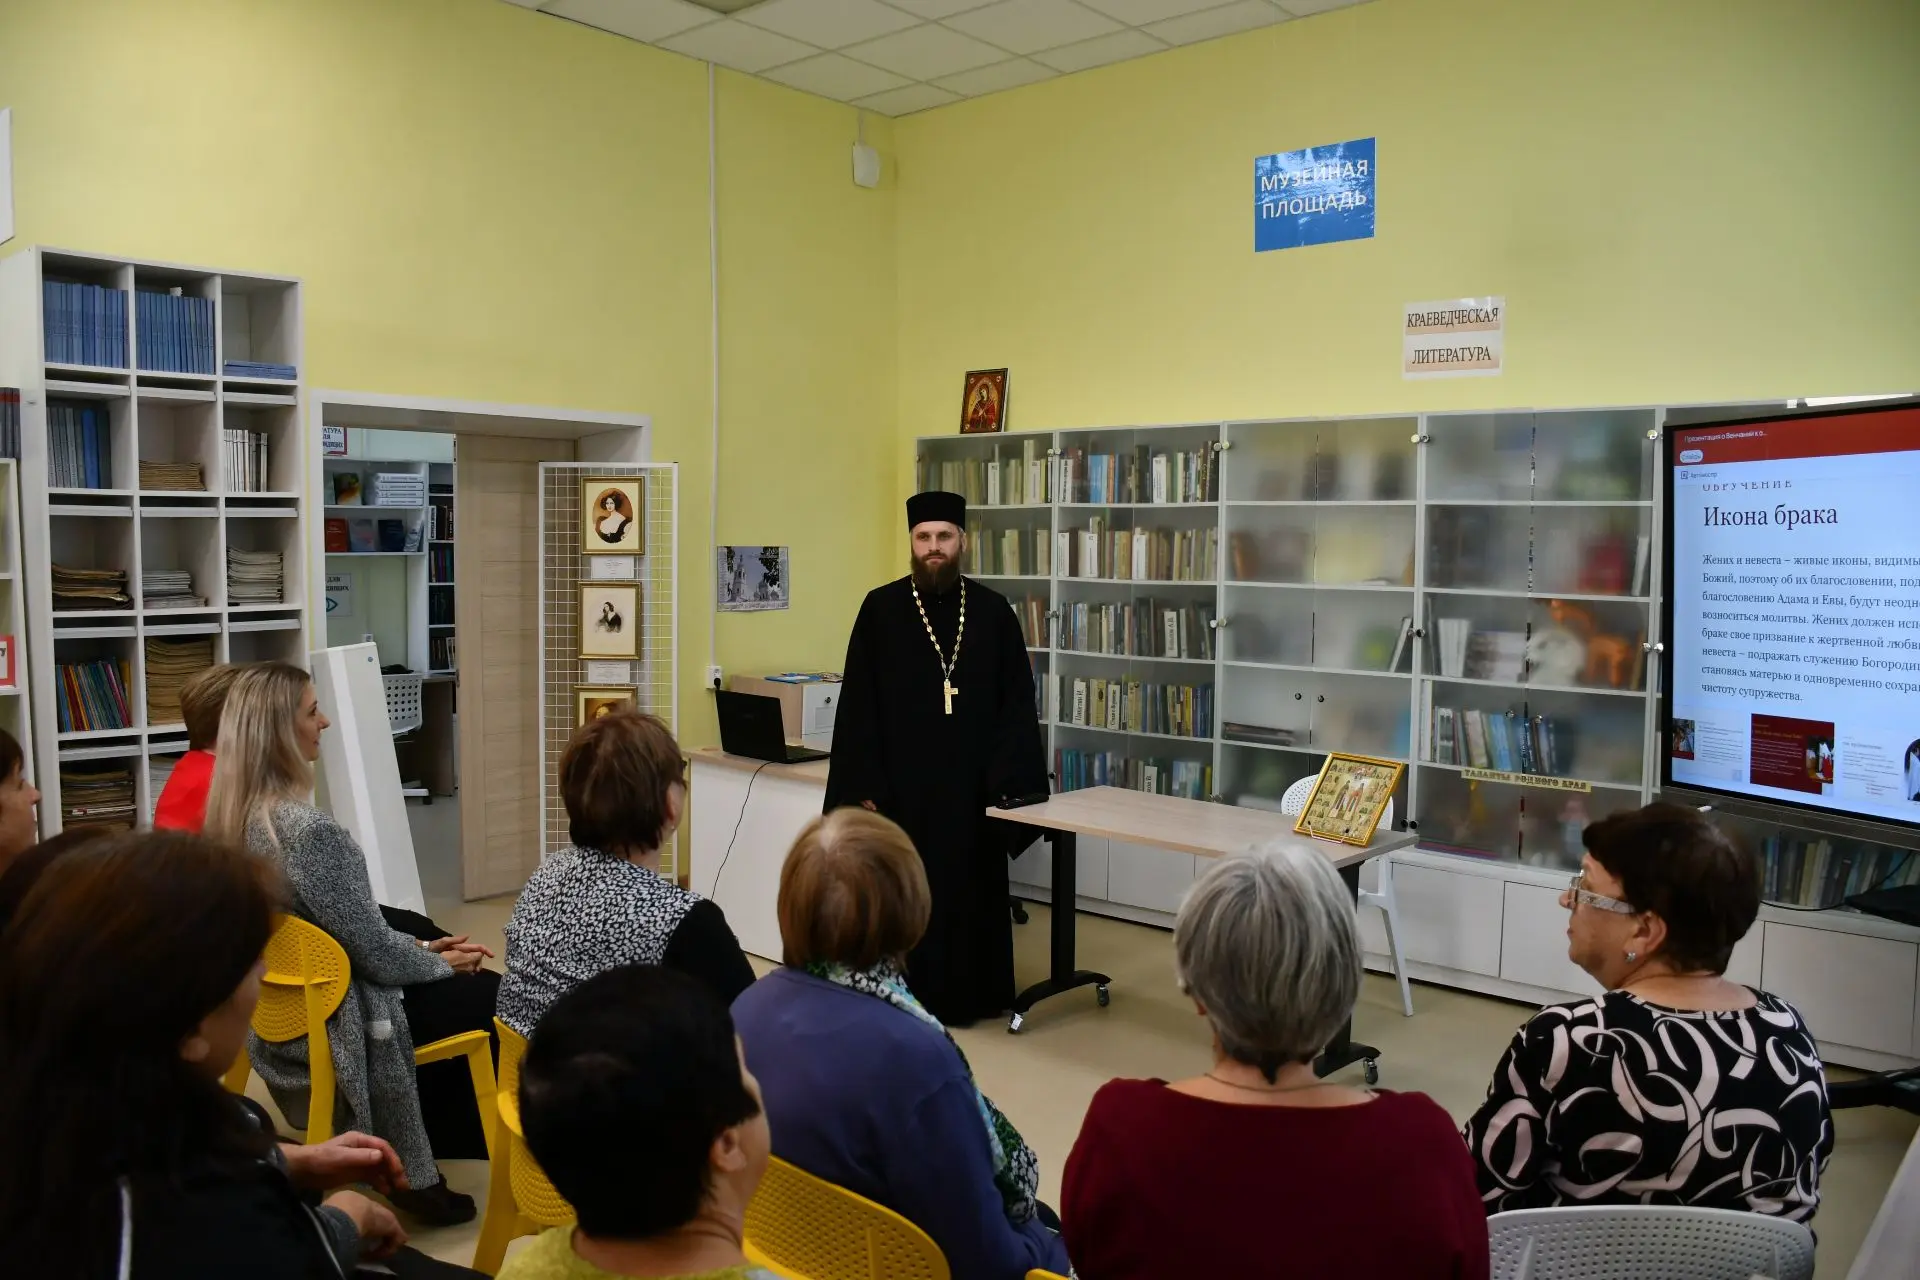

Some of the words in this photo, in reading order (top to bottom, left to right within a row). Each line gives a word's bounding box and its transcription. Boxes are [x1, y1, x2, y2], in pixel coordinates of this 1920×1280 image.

[1260, 158, 1368, 192] МУЗЕЙНАЯ
[1262, 189, 1367, 220] ПЛОЩАДЬ
[1407, 307, 1499, 329] КРАЕВЕДЧЕСКАЯ
[1412, 346, 1492, 365] ЛИТЕРАТУРА
[1704, 506, 1768, 526] Икона
[1774, 503, 1838, 531] брака
[1702, 554, 1734, 565] Жених
[1736, 557, 1742, 565] и
[1745, 557, 1782, 565] невеста
[1794, 557, 1829, 566] живые
[1832, 557, 1871, 567] иконы,
[1703, 572, 1737, 584] Божий,
[1739, 575, 1779, 586] поэтому
[1781, 574, 1793, 584] об
[1796, 577, 1808, 585] их
[1810, 574, 1897, 588] благословении,
[1702, 590, 1774, 603] благословению
[1777, 593, 1809, 605] Адама
[1822, 594, 1847, 606] Евы,
[1849, 595, 1881, 608] будут
[1702, 611, 1759, 622] возноситься
[1761, 614, 1809, 624] молитвы.
[1812, 613, 1849, 626] Жених
[1850, 618, 1894, 628] должен
[1702, 627, 1728, 640] браке
[1730, 631, 1750, 640] свое
[1752, 632, 1806, 644] призвание
[1808, 636, 1815, 644] к
[1817, 636, 1884, 648] жертвенной
[1702, 648, 1736, 658] невеста
[1748, 651, 1801, 663] подражать
[1803, 655, 1858, 667] служению
[1702, 666, 1747, 677] становясь
[1749, 670, 1792, 682] матерью
[1794, 674, 1800, 682] и
[1803, 674, 1883, 689] одновременно
[1701, 683, 1737, 697] чистоту
[1738, 687, 1804, 702] супружества.
[1464, 769, 1511, 781] ТАЛАНТЫ
[1514, 774, 1559, 787] РОДНОГО
[1562, 781, 1587, 790] КРАЯ
